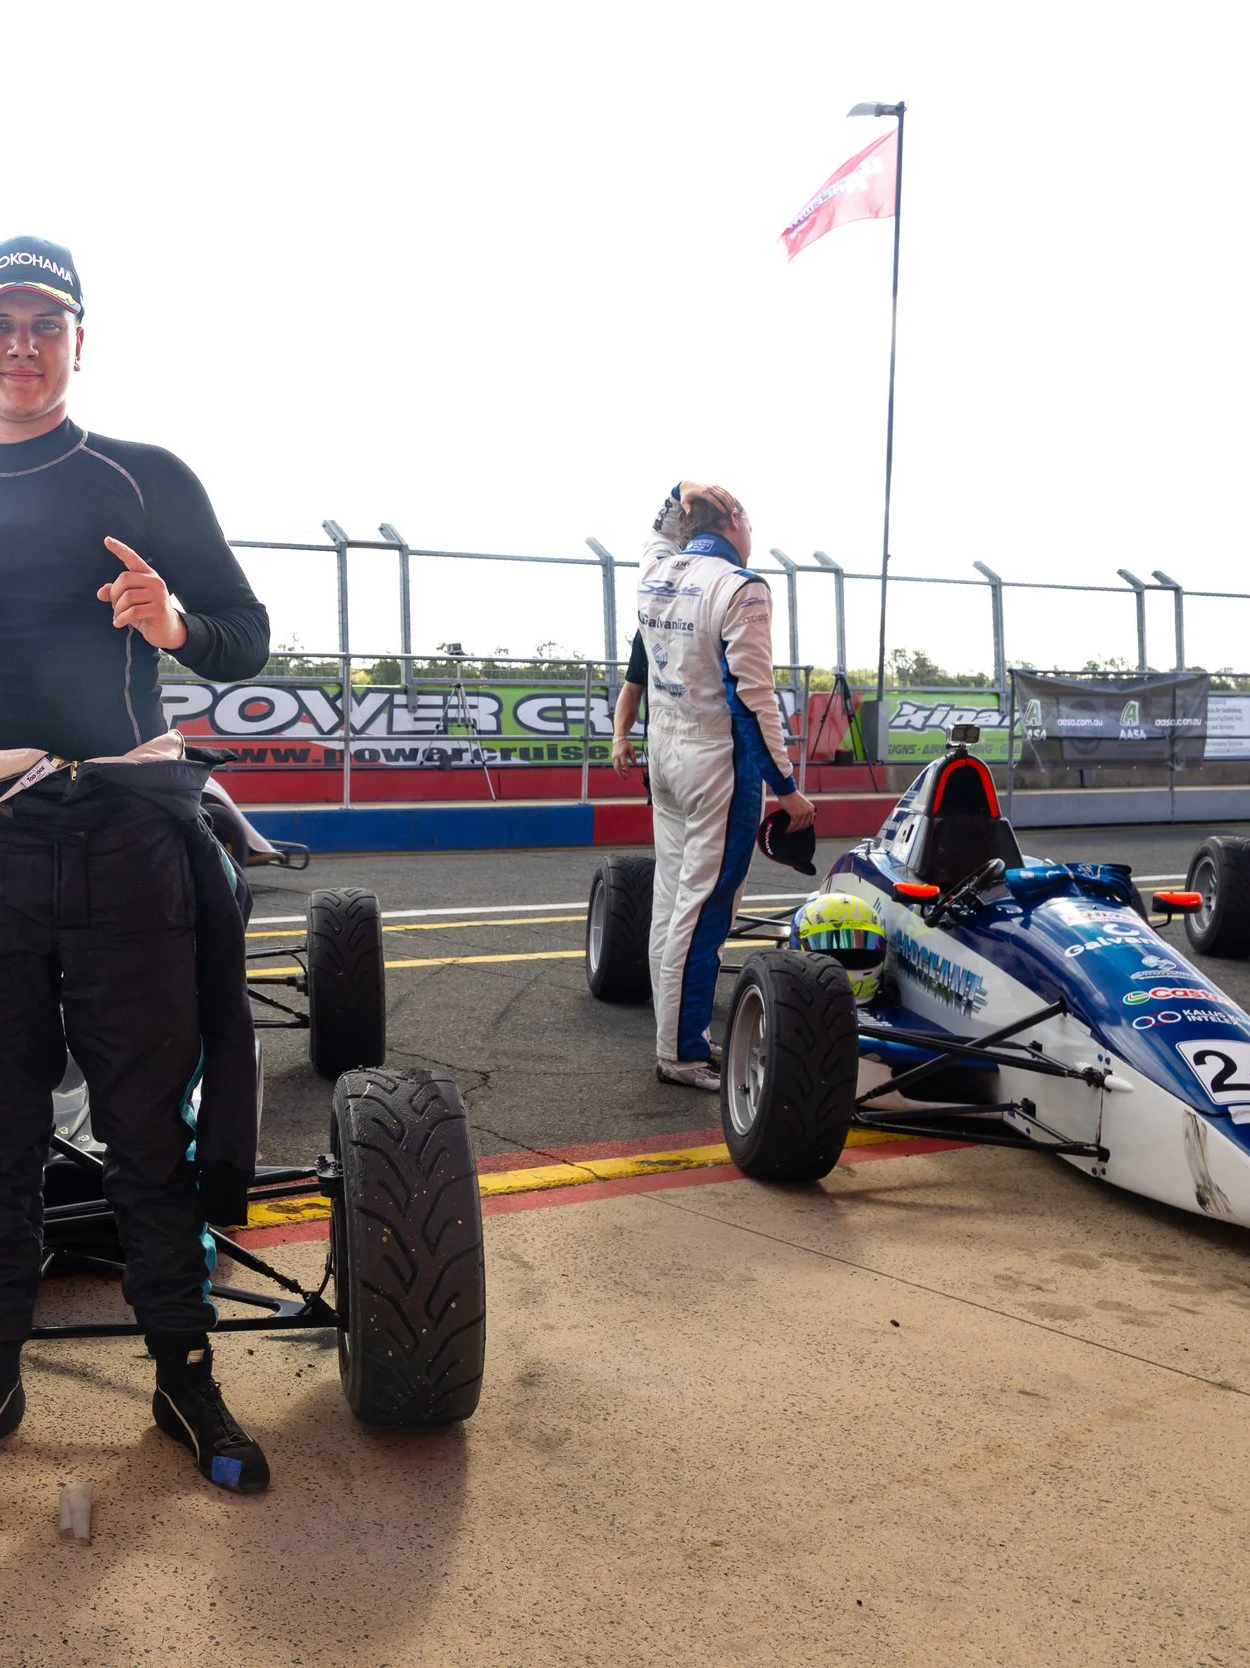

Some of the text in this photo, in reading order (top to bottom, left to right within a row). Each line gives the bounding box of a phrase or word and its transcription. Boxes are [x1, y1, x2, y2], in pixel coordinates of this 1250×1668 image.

[160, 684, 499, 734] POWER
[1119, 729, 1147, 740] AASA
[1193, 1050, 1250, 1093] 2
